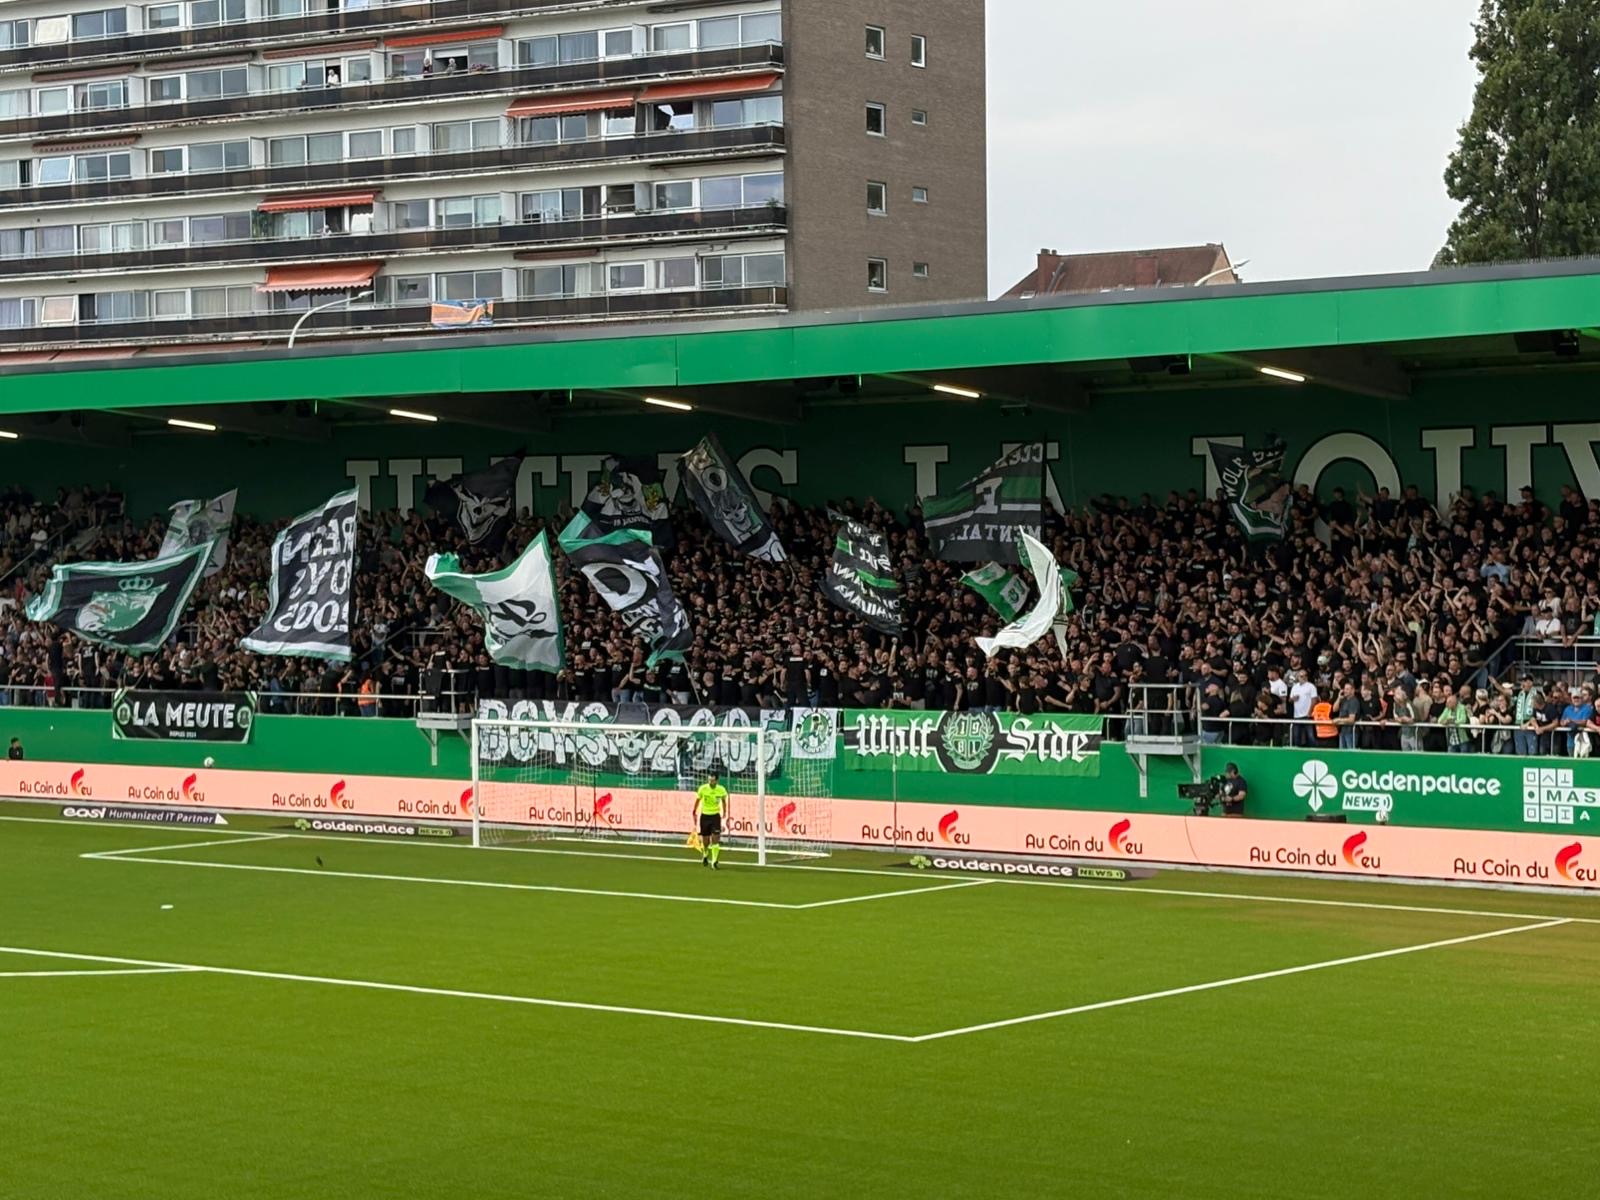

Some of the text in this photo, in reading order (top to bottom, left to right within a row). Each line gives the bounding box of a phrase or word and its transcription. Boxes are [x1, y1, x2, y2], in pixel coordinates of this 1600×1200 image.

[132, 701, 236, 728] LA MEUTE
[479, 699, 610, 766] BOYS
[856, 714, 933, 759] Wolf
[1006, 717, 1089, 763] Side
[19, 781, 31, 793] Au
[33, 781, 54, 794] Coin
[55, 782, 68, 795] du
[1342, 769, 1501, 796] Goldenpalace
[128, 786, 141, 798] Au
[143, 787, 165, 799] Coin
[166, 787, 180, 800] du
[272, 793, 286, 806] Au
[288, 793, 311, 807] Coin
[313, 794, 327, 808] du
[398, 787, 485, 816] Au Coin du Fu
[1345, 795, 1380, 808] NEWS
[108, 809, 164, 821] Humanized
[165, 813, 175, 821] IT
[176, 813, 214, 824] Partner
[529, 807, 544, 820] Au
[547, 807, 573, 821] Coin
[575, 808, 591, 822] du
[312, 820, 415, 835] Goldenpalace
[726, 817, 753, 832] Coin
[861, 824, 880, 840] Au
[883, 825, 913, 842] Coin
[916, 827, 934, 843] du
[1025, 834, 1045, 849] Au
[1048, 834, 1080, 852] Coin
[1084, 836, 1104, 852] du
[1250, 846, 1271, 863] Au
[1275, 848, 1310, 866] Coin
[1315, 848, 1337, 866] du
[932, 858, 1073, 877] Goldenpalace
[1454, 857, 1476, 874] Au
[1482, 859, 1520, 878] Coin
[1526, 860, 1549, 879] du
